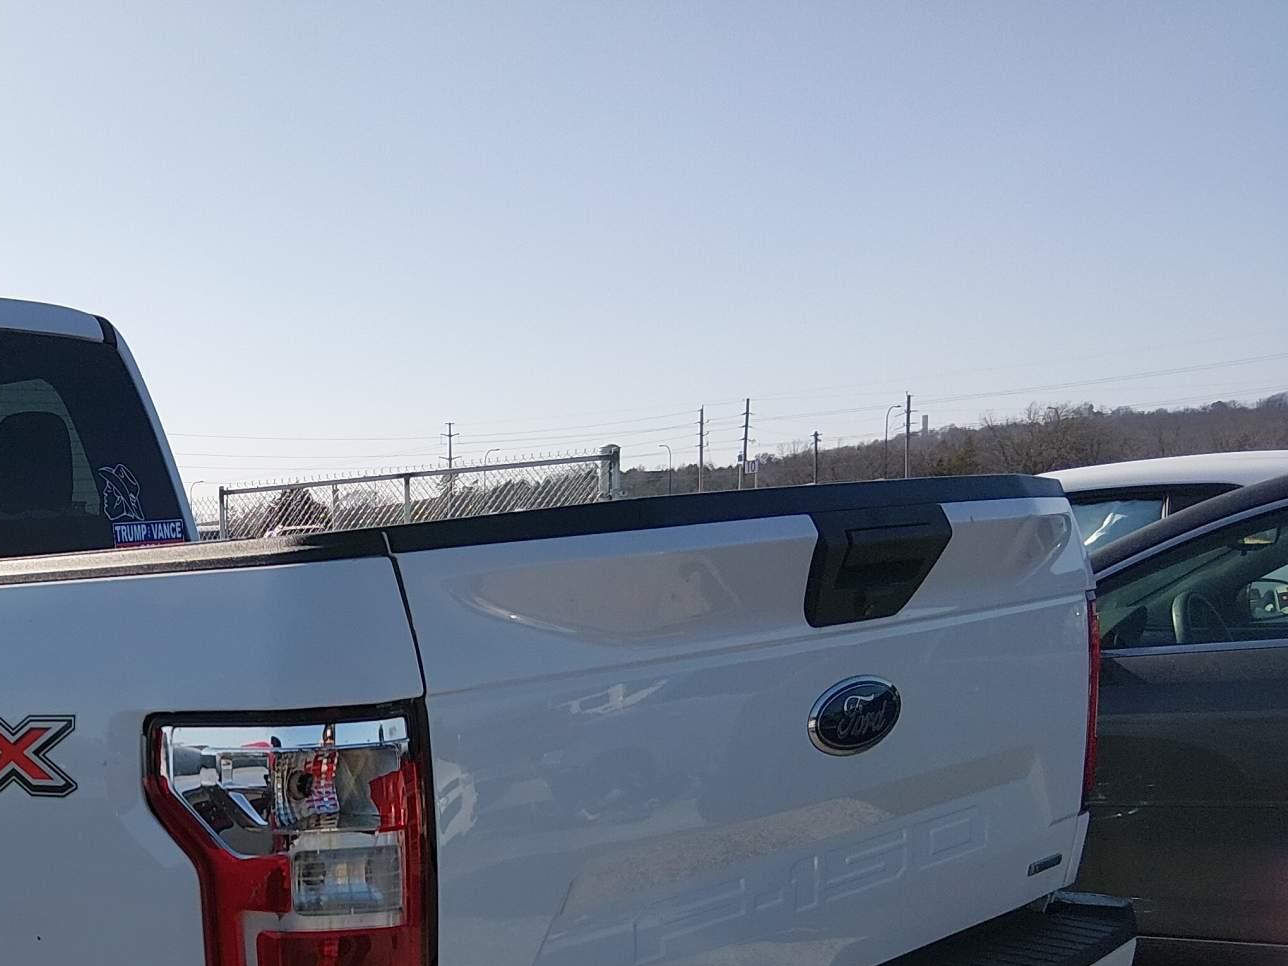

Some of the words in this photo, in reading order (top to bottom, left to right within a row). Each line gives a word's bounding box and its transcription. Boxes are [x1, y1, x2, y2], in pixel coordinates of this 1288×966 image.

[114, 524, 146, 542] TRUMP
[151, 522, 182, 539] VANCE
[836, 693, 889, 739] Ford
